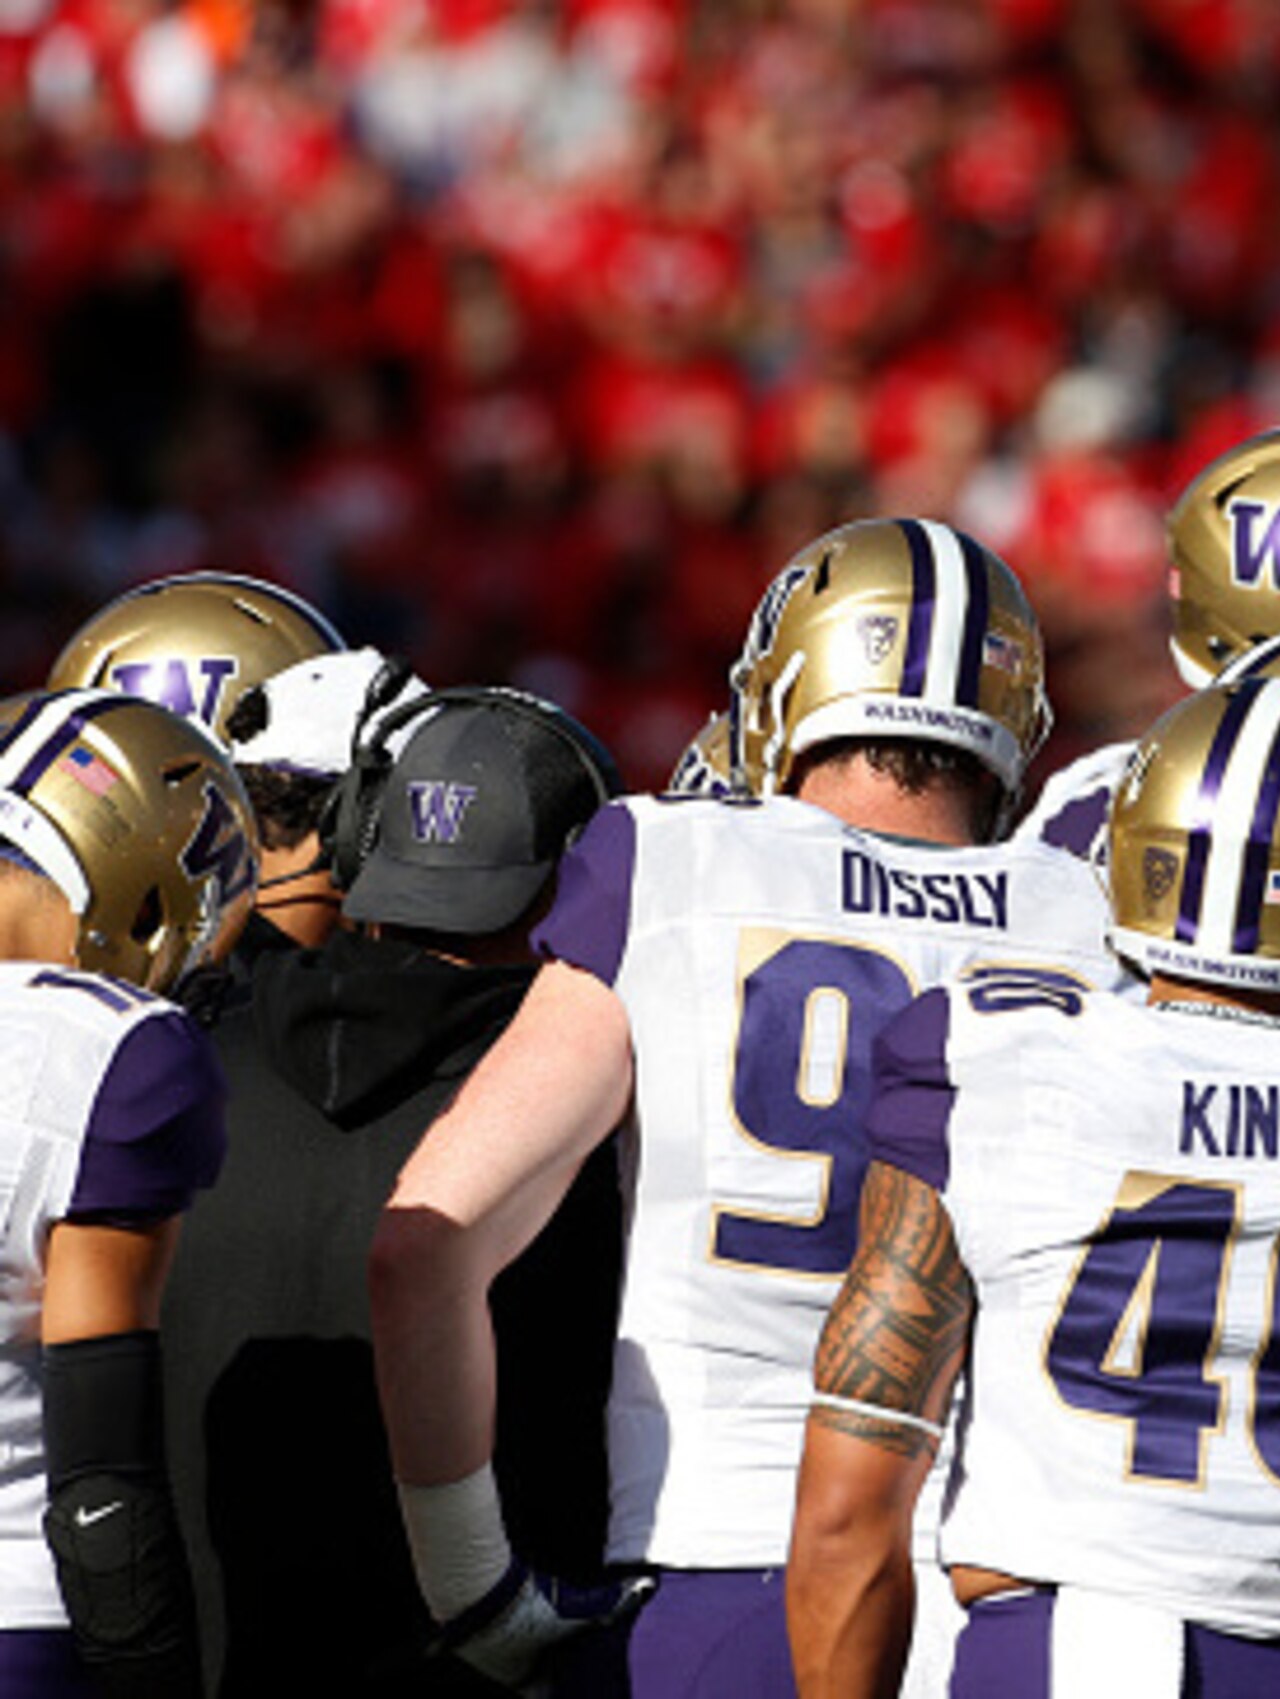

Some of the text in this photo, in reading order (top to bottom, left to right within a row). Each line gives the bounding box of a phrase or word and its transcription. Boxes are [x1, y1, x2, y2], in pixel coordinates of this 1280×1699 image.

[864, 701, 993, 741] WASHINGTON
[405, 781, 478, 843] W
[841, 847, 1008, 930] DISSLY
[1146, 944, 1280, 985] WASHINGTON
